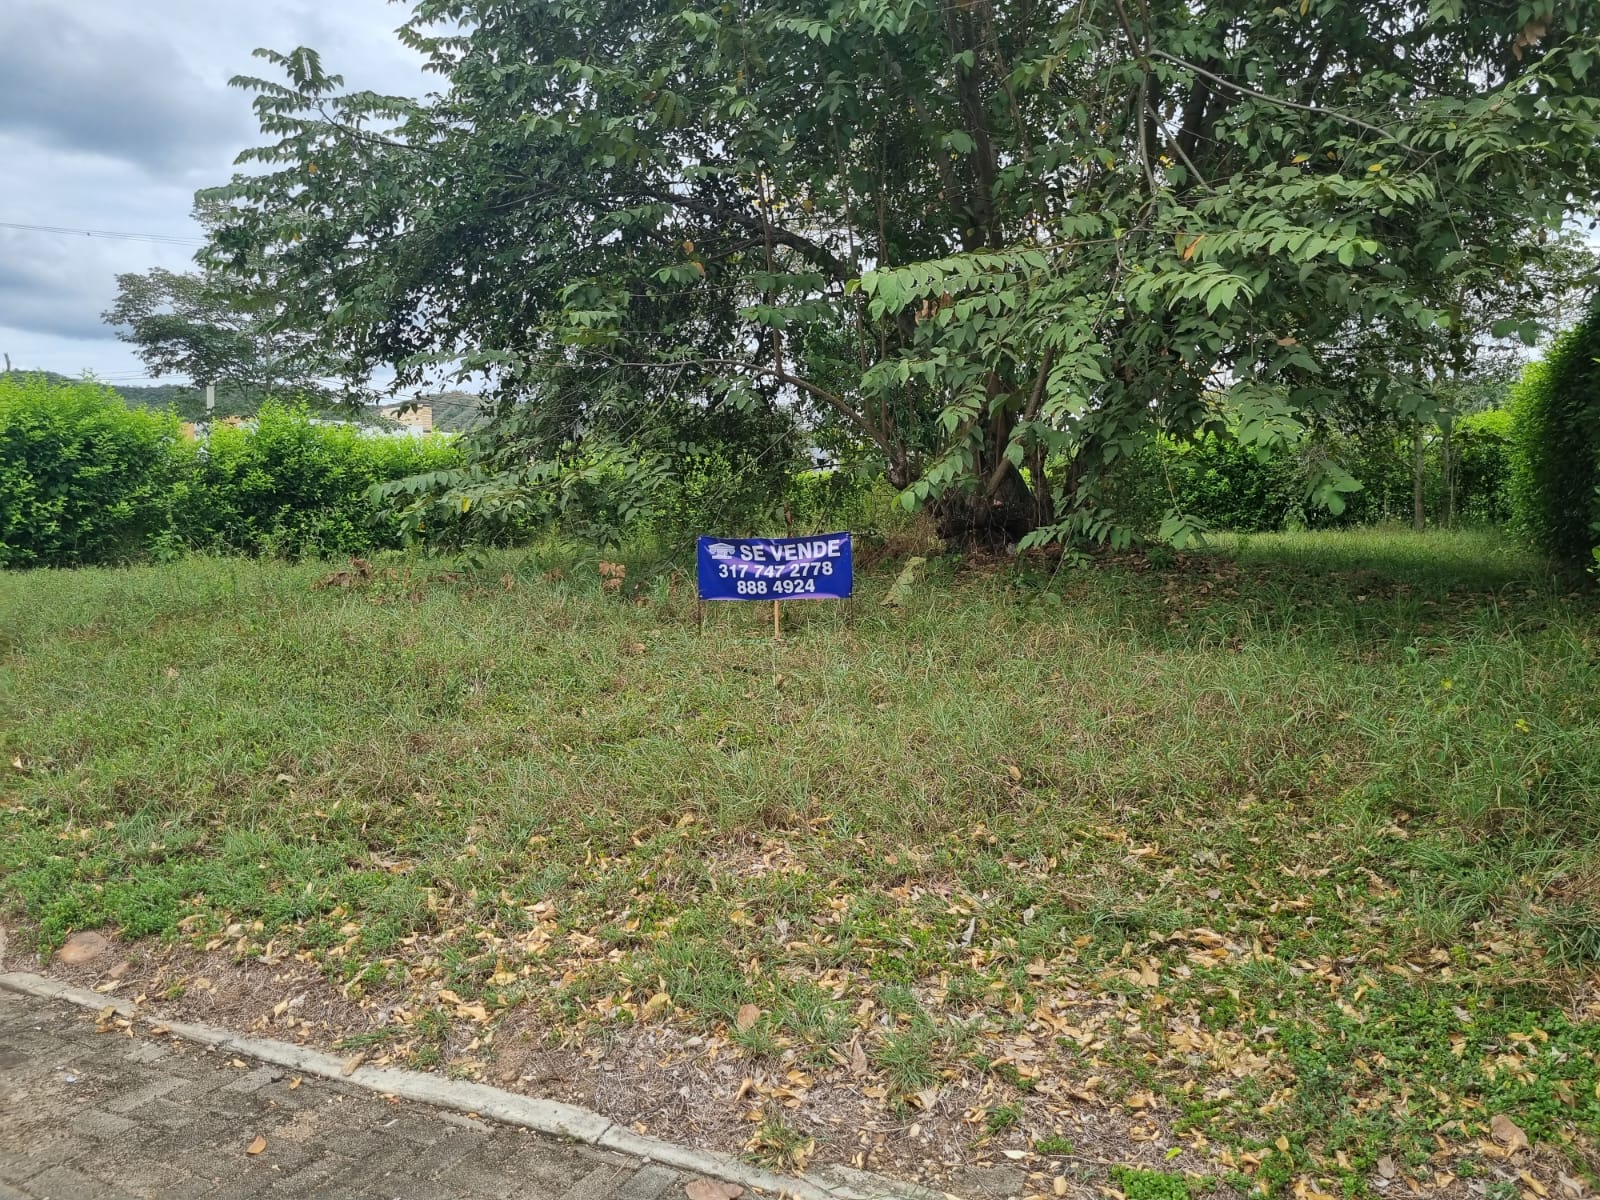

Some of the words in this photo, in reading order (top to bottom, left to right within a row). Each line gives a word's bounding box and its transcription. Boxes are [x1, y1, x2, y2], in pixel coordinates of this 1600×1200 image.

[740, 544, 766, 561] SE
[770, 539, 841, 561] VENDE
[719, 564, 748, 578] 317
[755, 564, 785, 578] 747
[789, 561, 833, 577] 2778
[737, 580, 767, 594] 888
[773, 578, 815, 593] 4924
